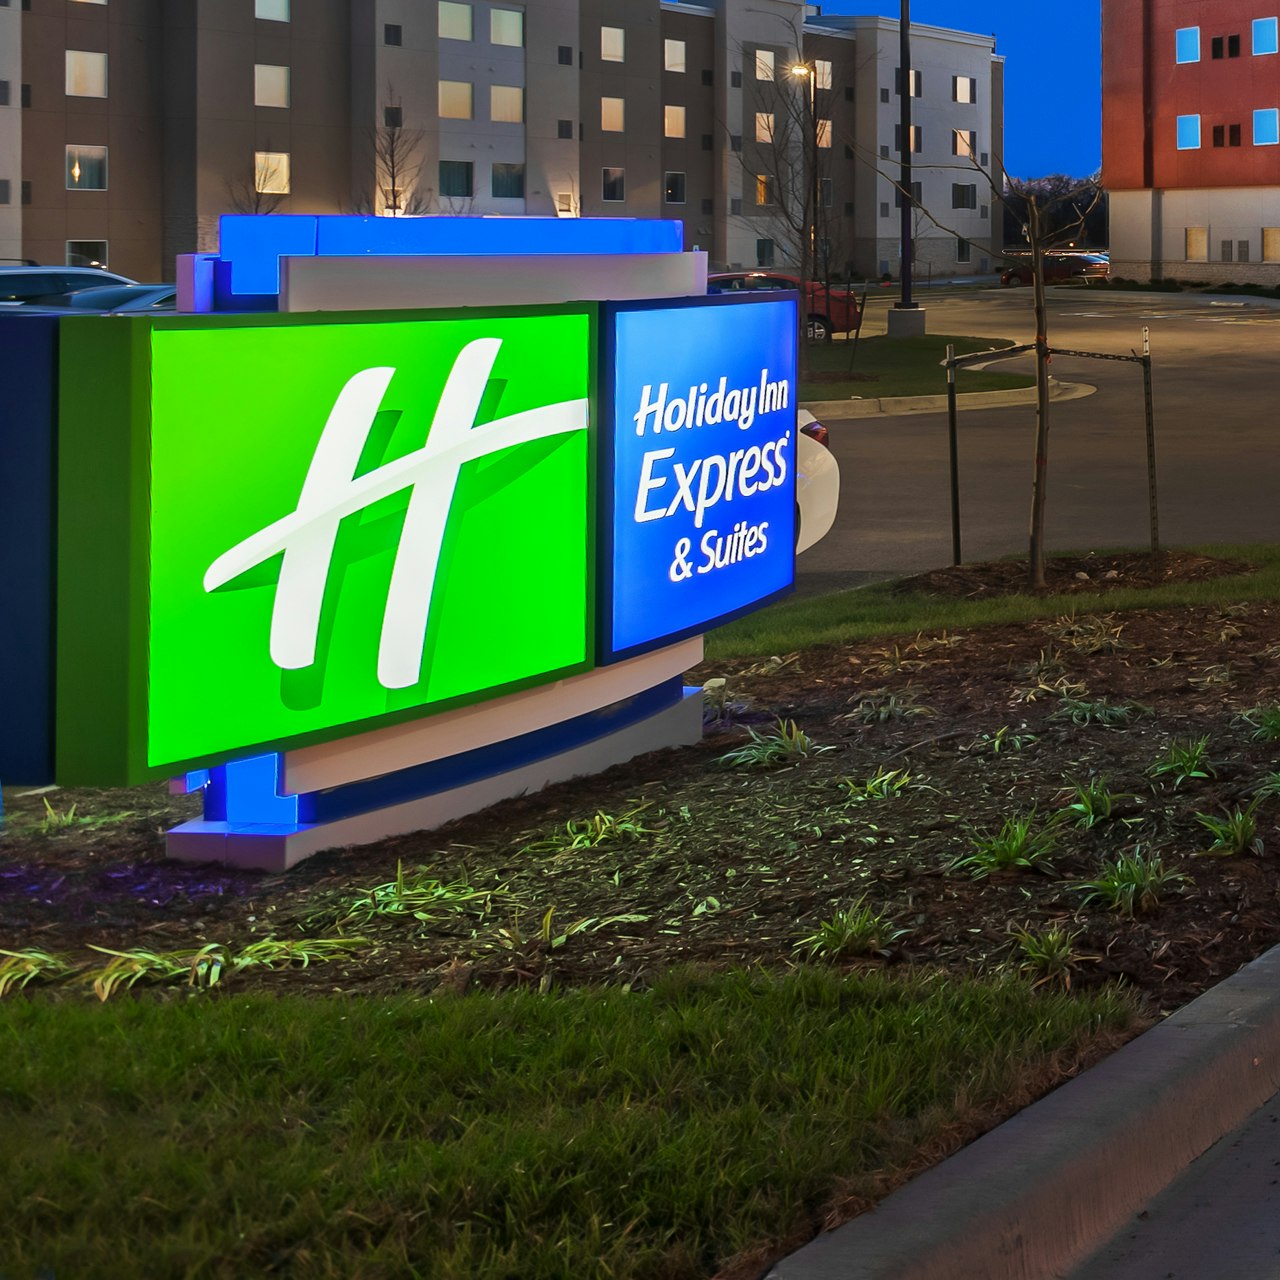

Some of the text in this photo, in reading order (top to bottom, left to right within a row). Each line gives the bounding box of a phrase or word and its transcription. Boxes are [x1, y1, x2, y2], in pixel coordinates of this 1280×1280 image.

[633, 368, 789, 437] Holiday Inn
[203, 337, 589, 690] H
[634, 436, 789, 529] Express
[669, 520, 769, 583] & Suites
